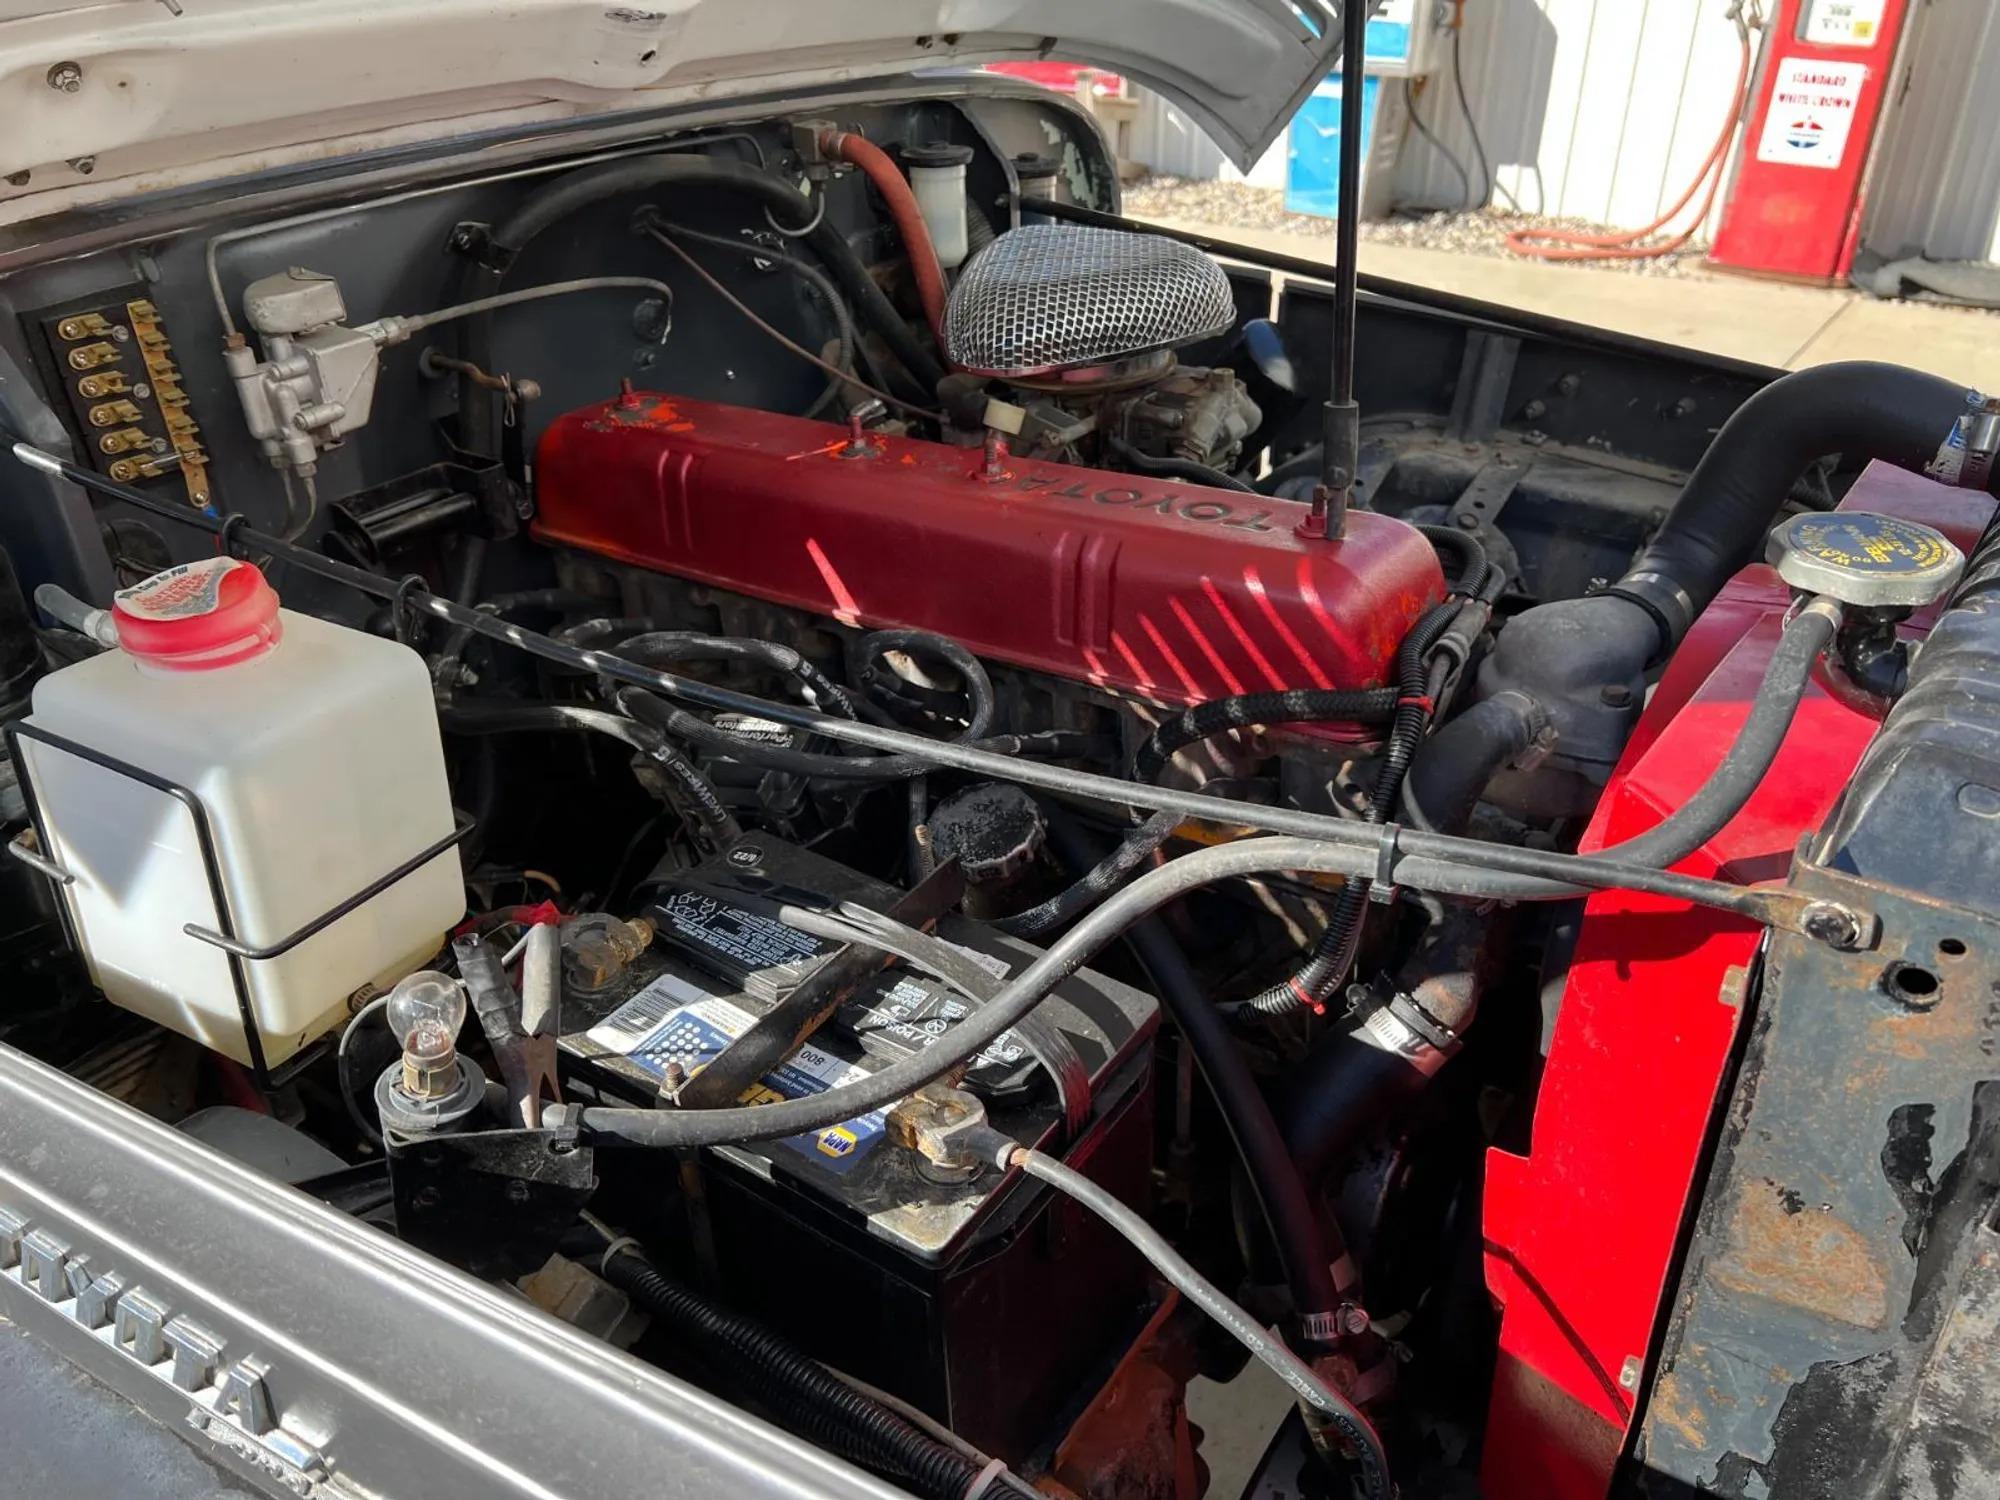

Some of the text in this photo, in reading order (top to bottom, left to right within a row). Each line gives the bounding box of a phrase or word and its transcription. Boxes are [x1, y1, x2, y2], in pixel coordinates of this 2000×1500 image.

[1014, 470, 1276, 532] TOYOTA
[868, 1015, 917, 1039] POISON
[800, 1050, 825, 1066] 800
[822, 1131, 852, 1153] NAPA
